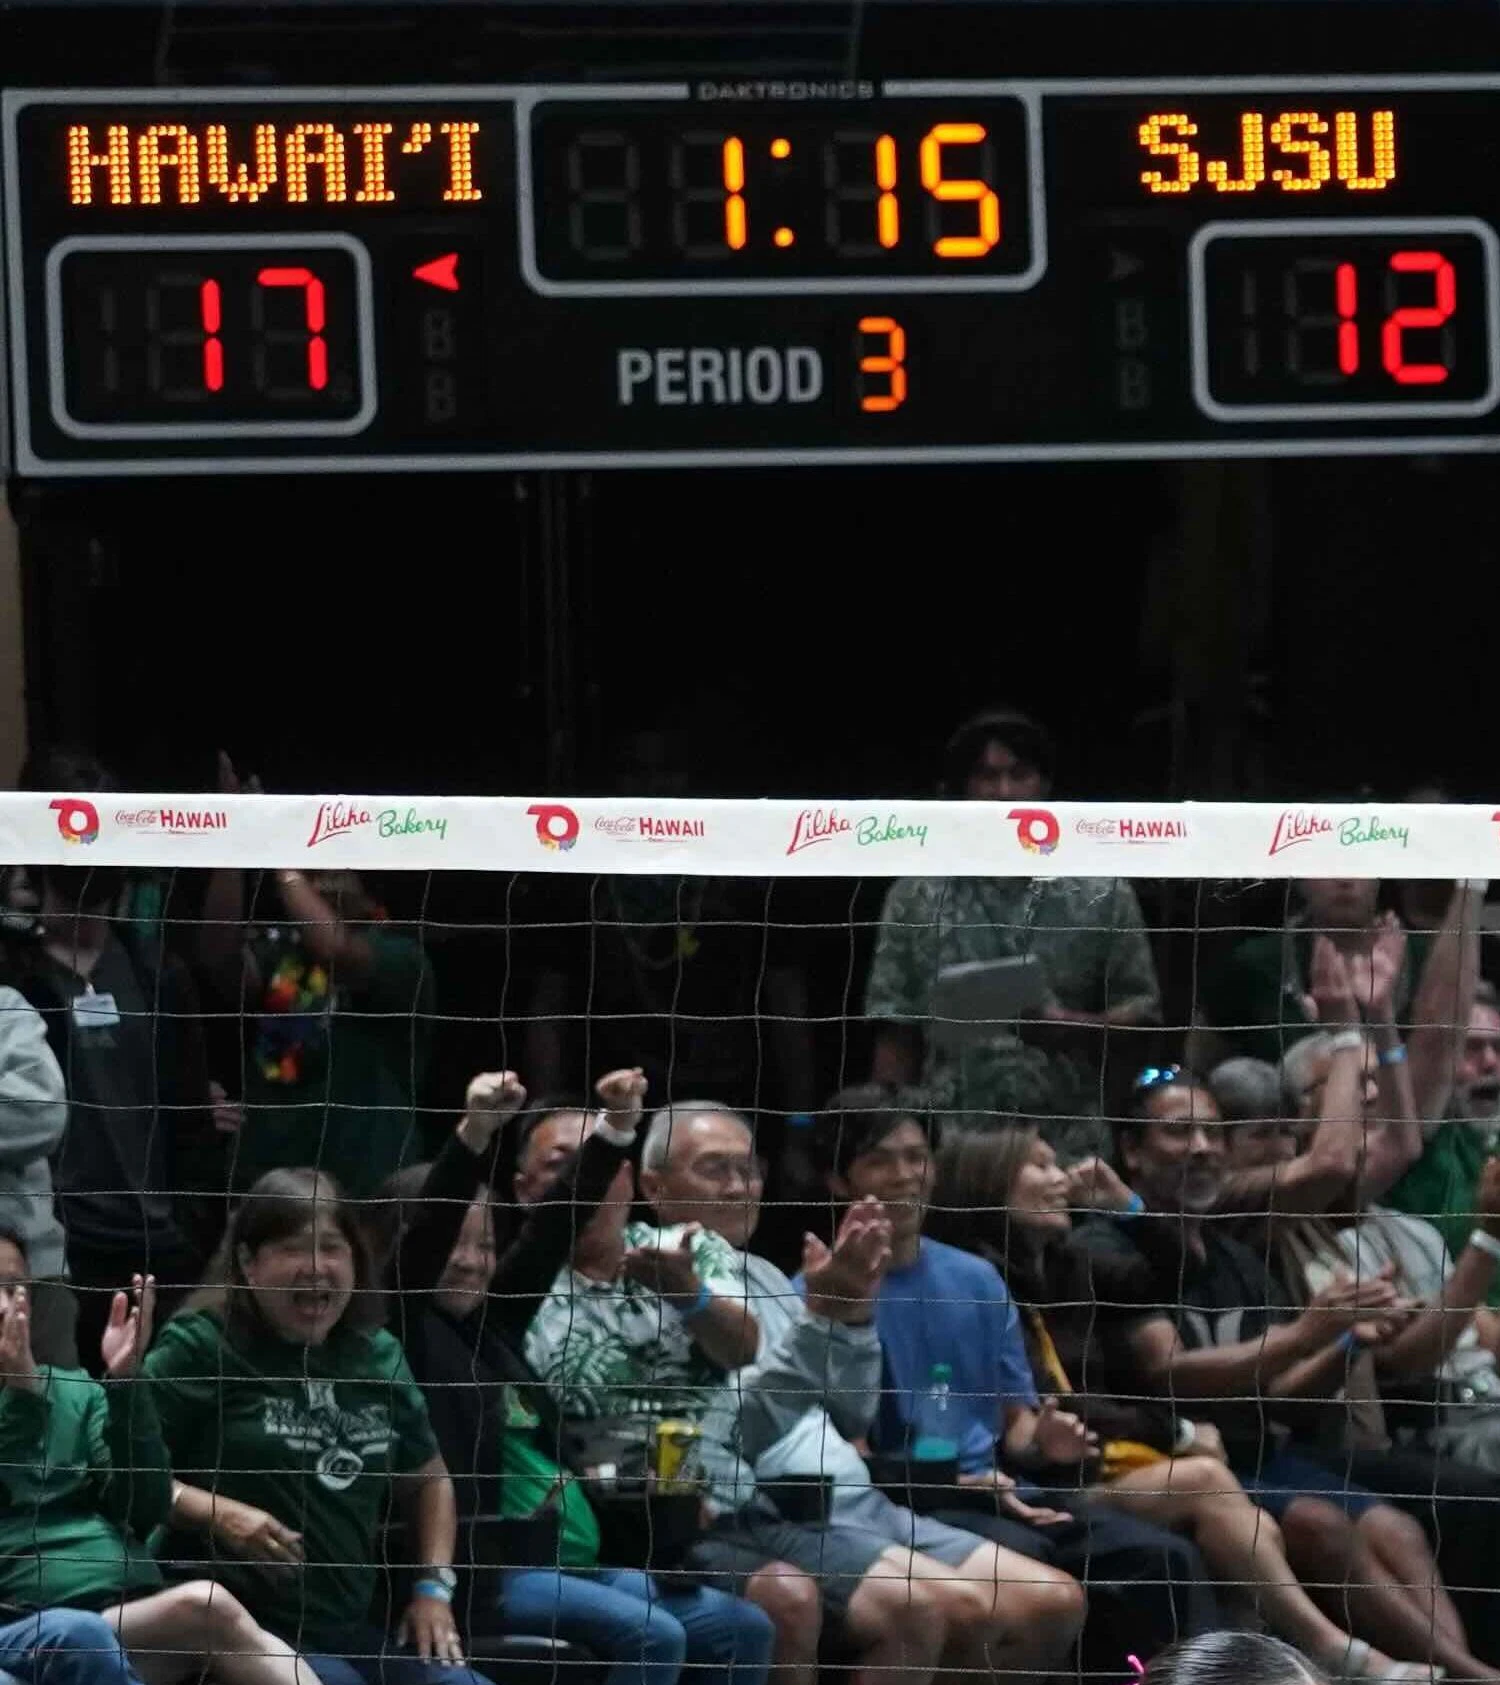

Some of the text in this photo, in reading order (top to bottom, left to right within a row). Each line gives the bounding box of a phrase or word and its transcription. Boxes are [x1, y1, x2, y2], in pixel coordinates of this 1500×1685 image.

[1138, 110, 1397, 193] SJSU
[723, 121, 1001, 259] 1:15
[201, 267, 329, 393] 17
[1335, 251, 1457, 385] 12
[617, 316, 906, 412] PERIOD 3
[160, 809, 228, 830] HAWAII
[307, 801, 448, 847] Liliha Bakery
[639, 816, 705, 838] HAWAII
[786, 809, 929, 856] Liliha Bakery
[1120, 818, 1188, 838] HAWAII
[1269, 812, 1409, 856] Liliha Bakery
